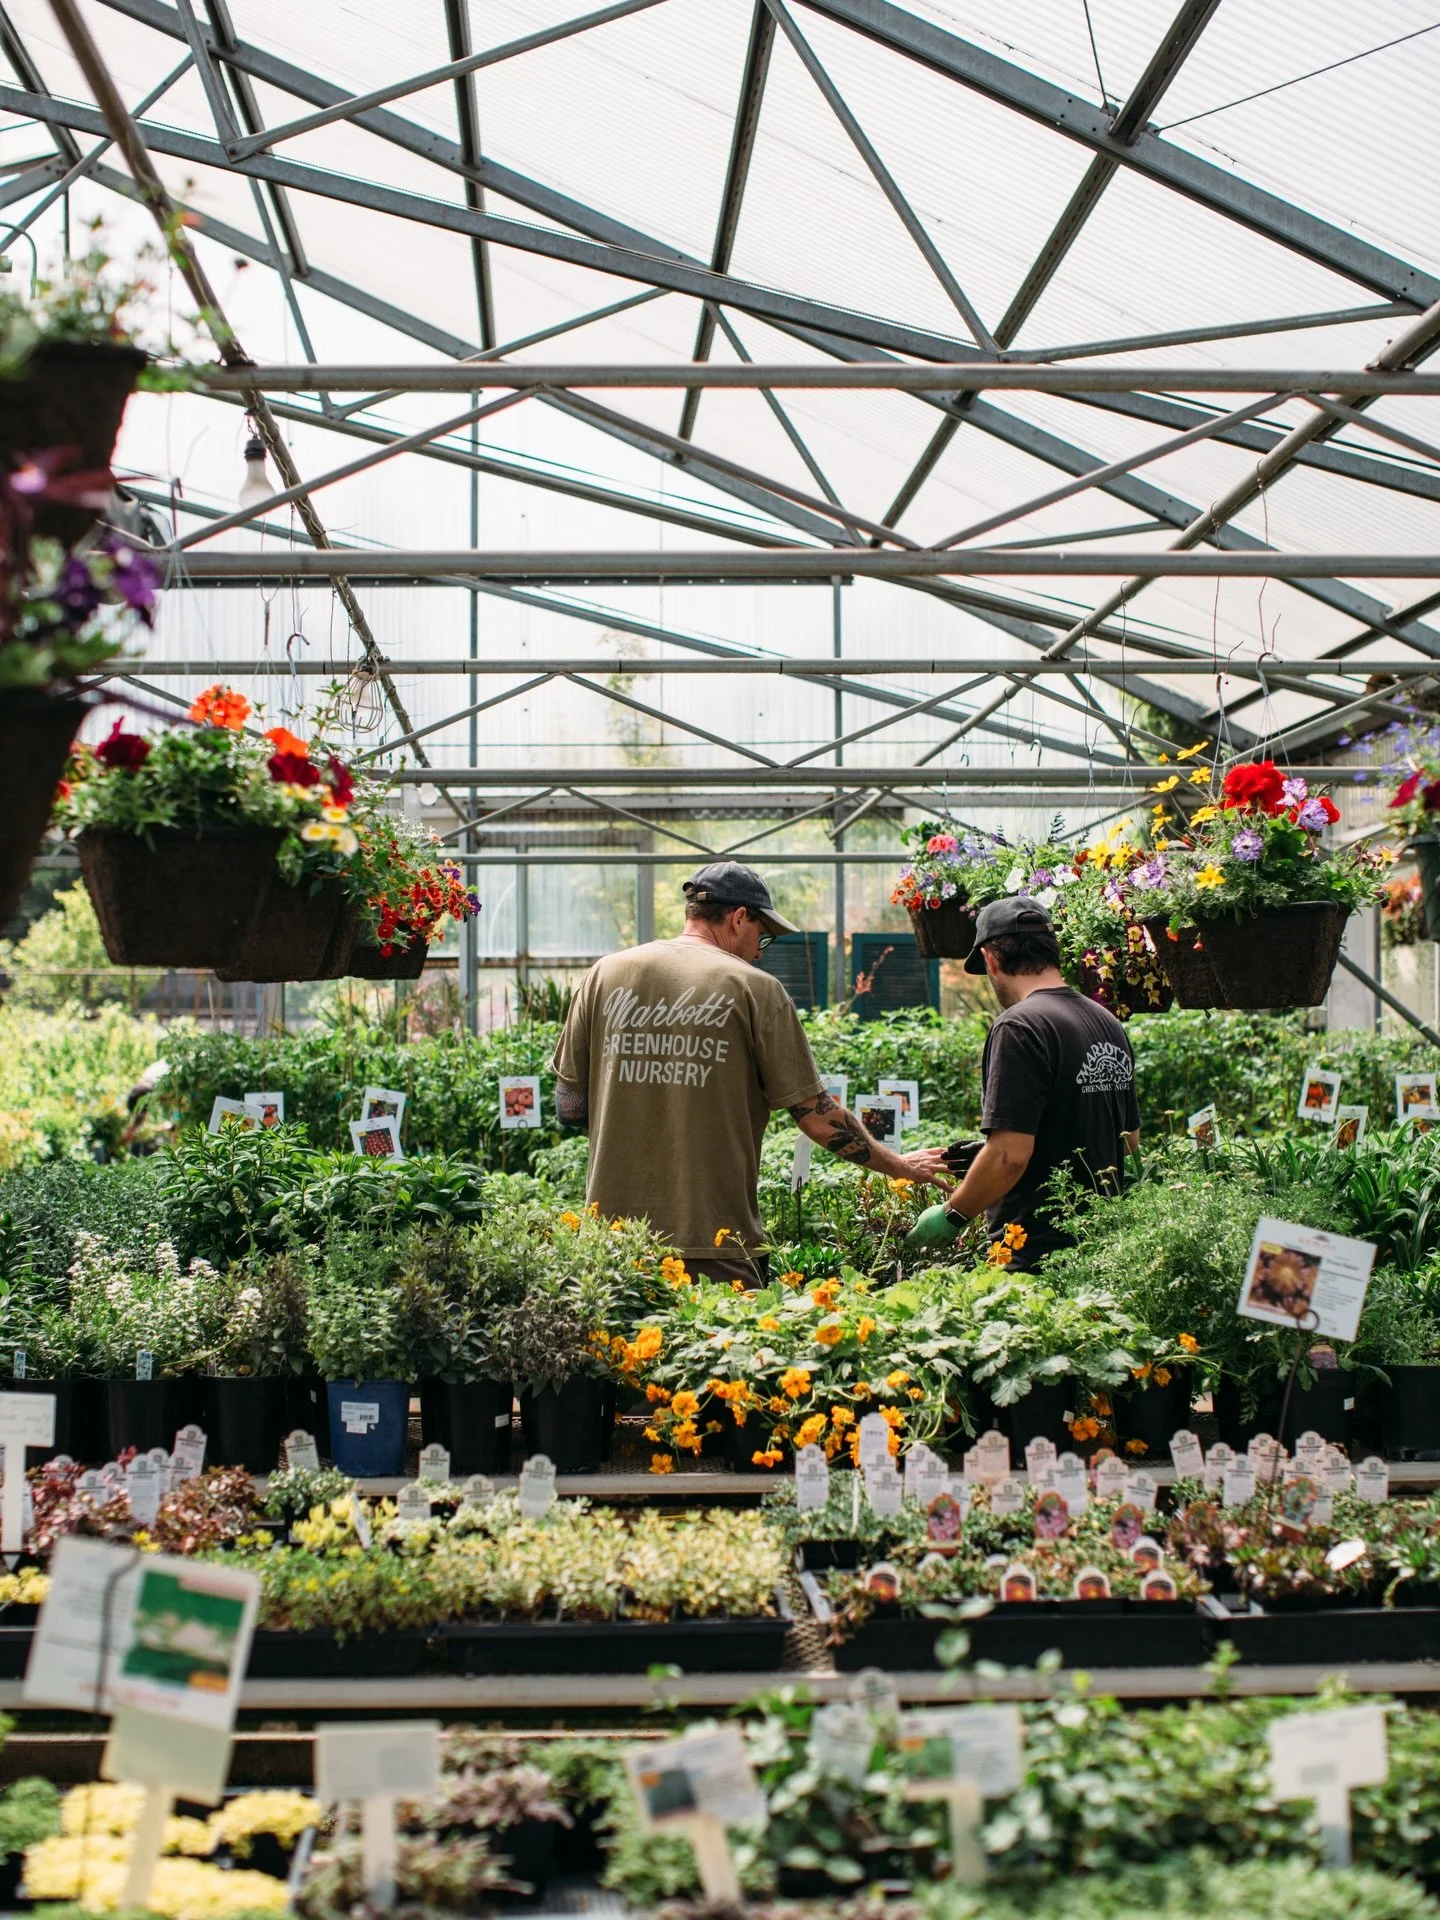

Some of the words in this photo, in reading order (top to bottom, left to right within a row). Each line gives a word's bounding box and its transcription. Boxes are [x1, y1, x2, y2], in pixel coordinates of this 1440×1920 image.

[602, 985, 736, 1030] Marbott's
[602, 1033, 730, 1063] GREENHOUSE
[618, 1060, 713, 1088] NURSERY
